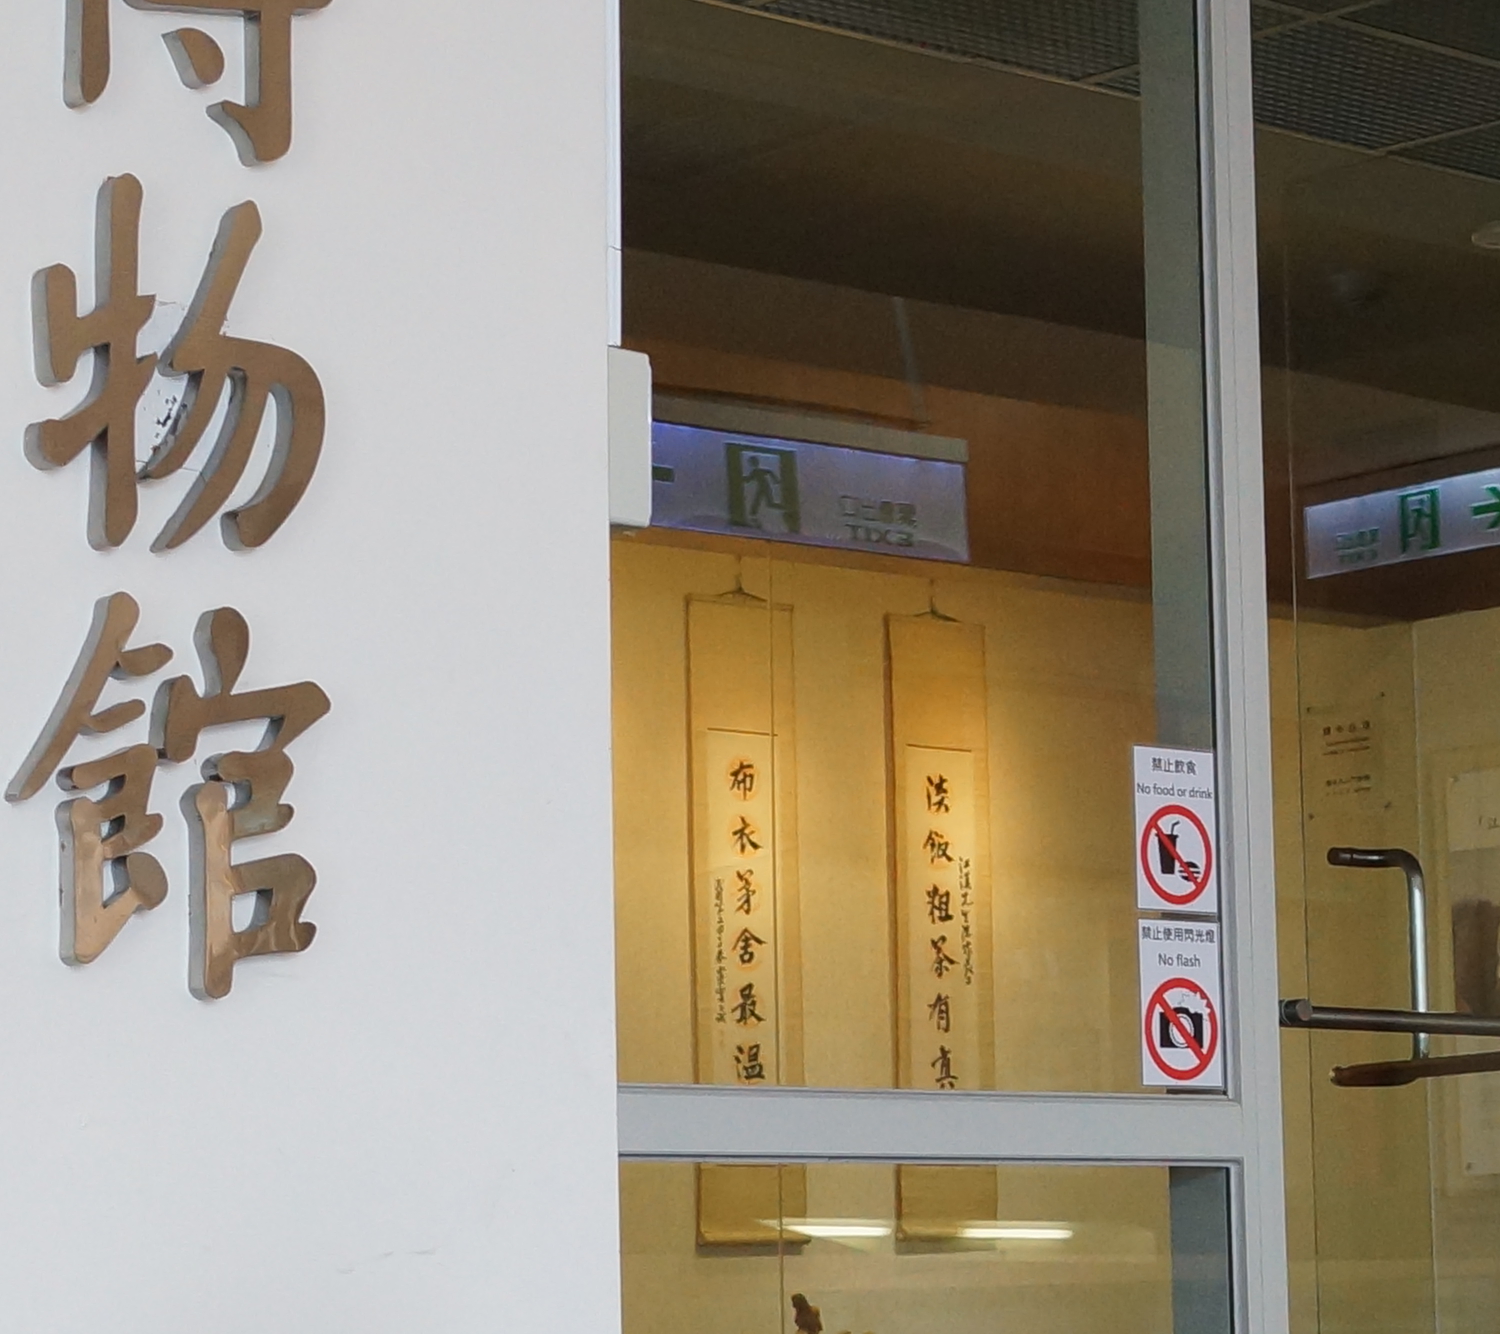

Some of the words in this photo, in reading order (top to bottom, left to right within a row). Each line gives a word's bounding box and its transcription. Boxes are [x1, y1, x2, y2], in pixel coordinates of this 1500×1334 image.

[1151, 756, 1197, 776] 禁止飲食
[1137, 783, 1151, 795] No
[1153, 783, 1175, 797] food
[1176, 788, 1187, 798] or
[1188, 786, 1213, 799] drink
[1141, 925, 1216, 944] 禁止使用閃光燈
[1158, 953, 1174, 967] No
[1176, 953, 1201, 968] flash
